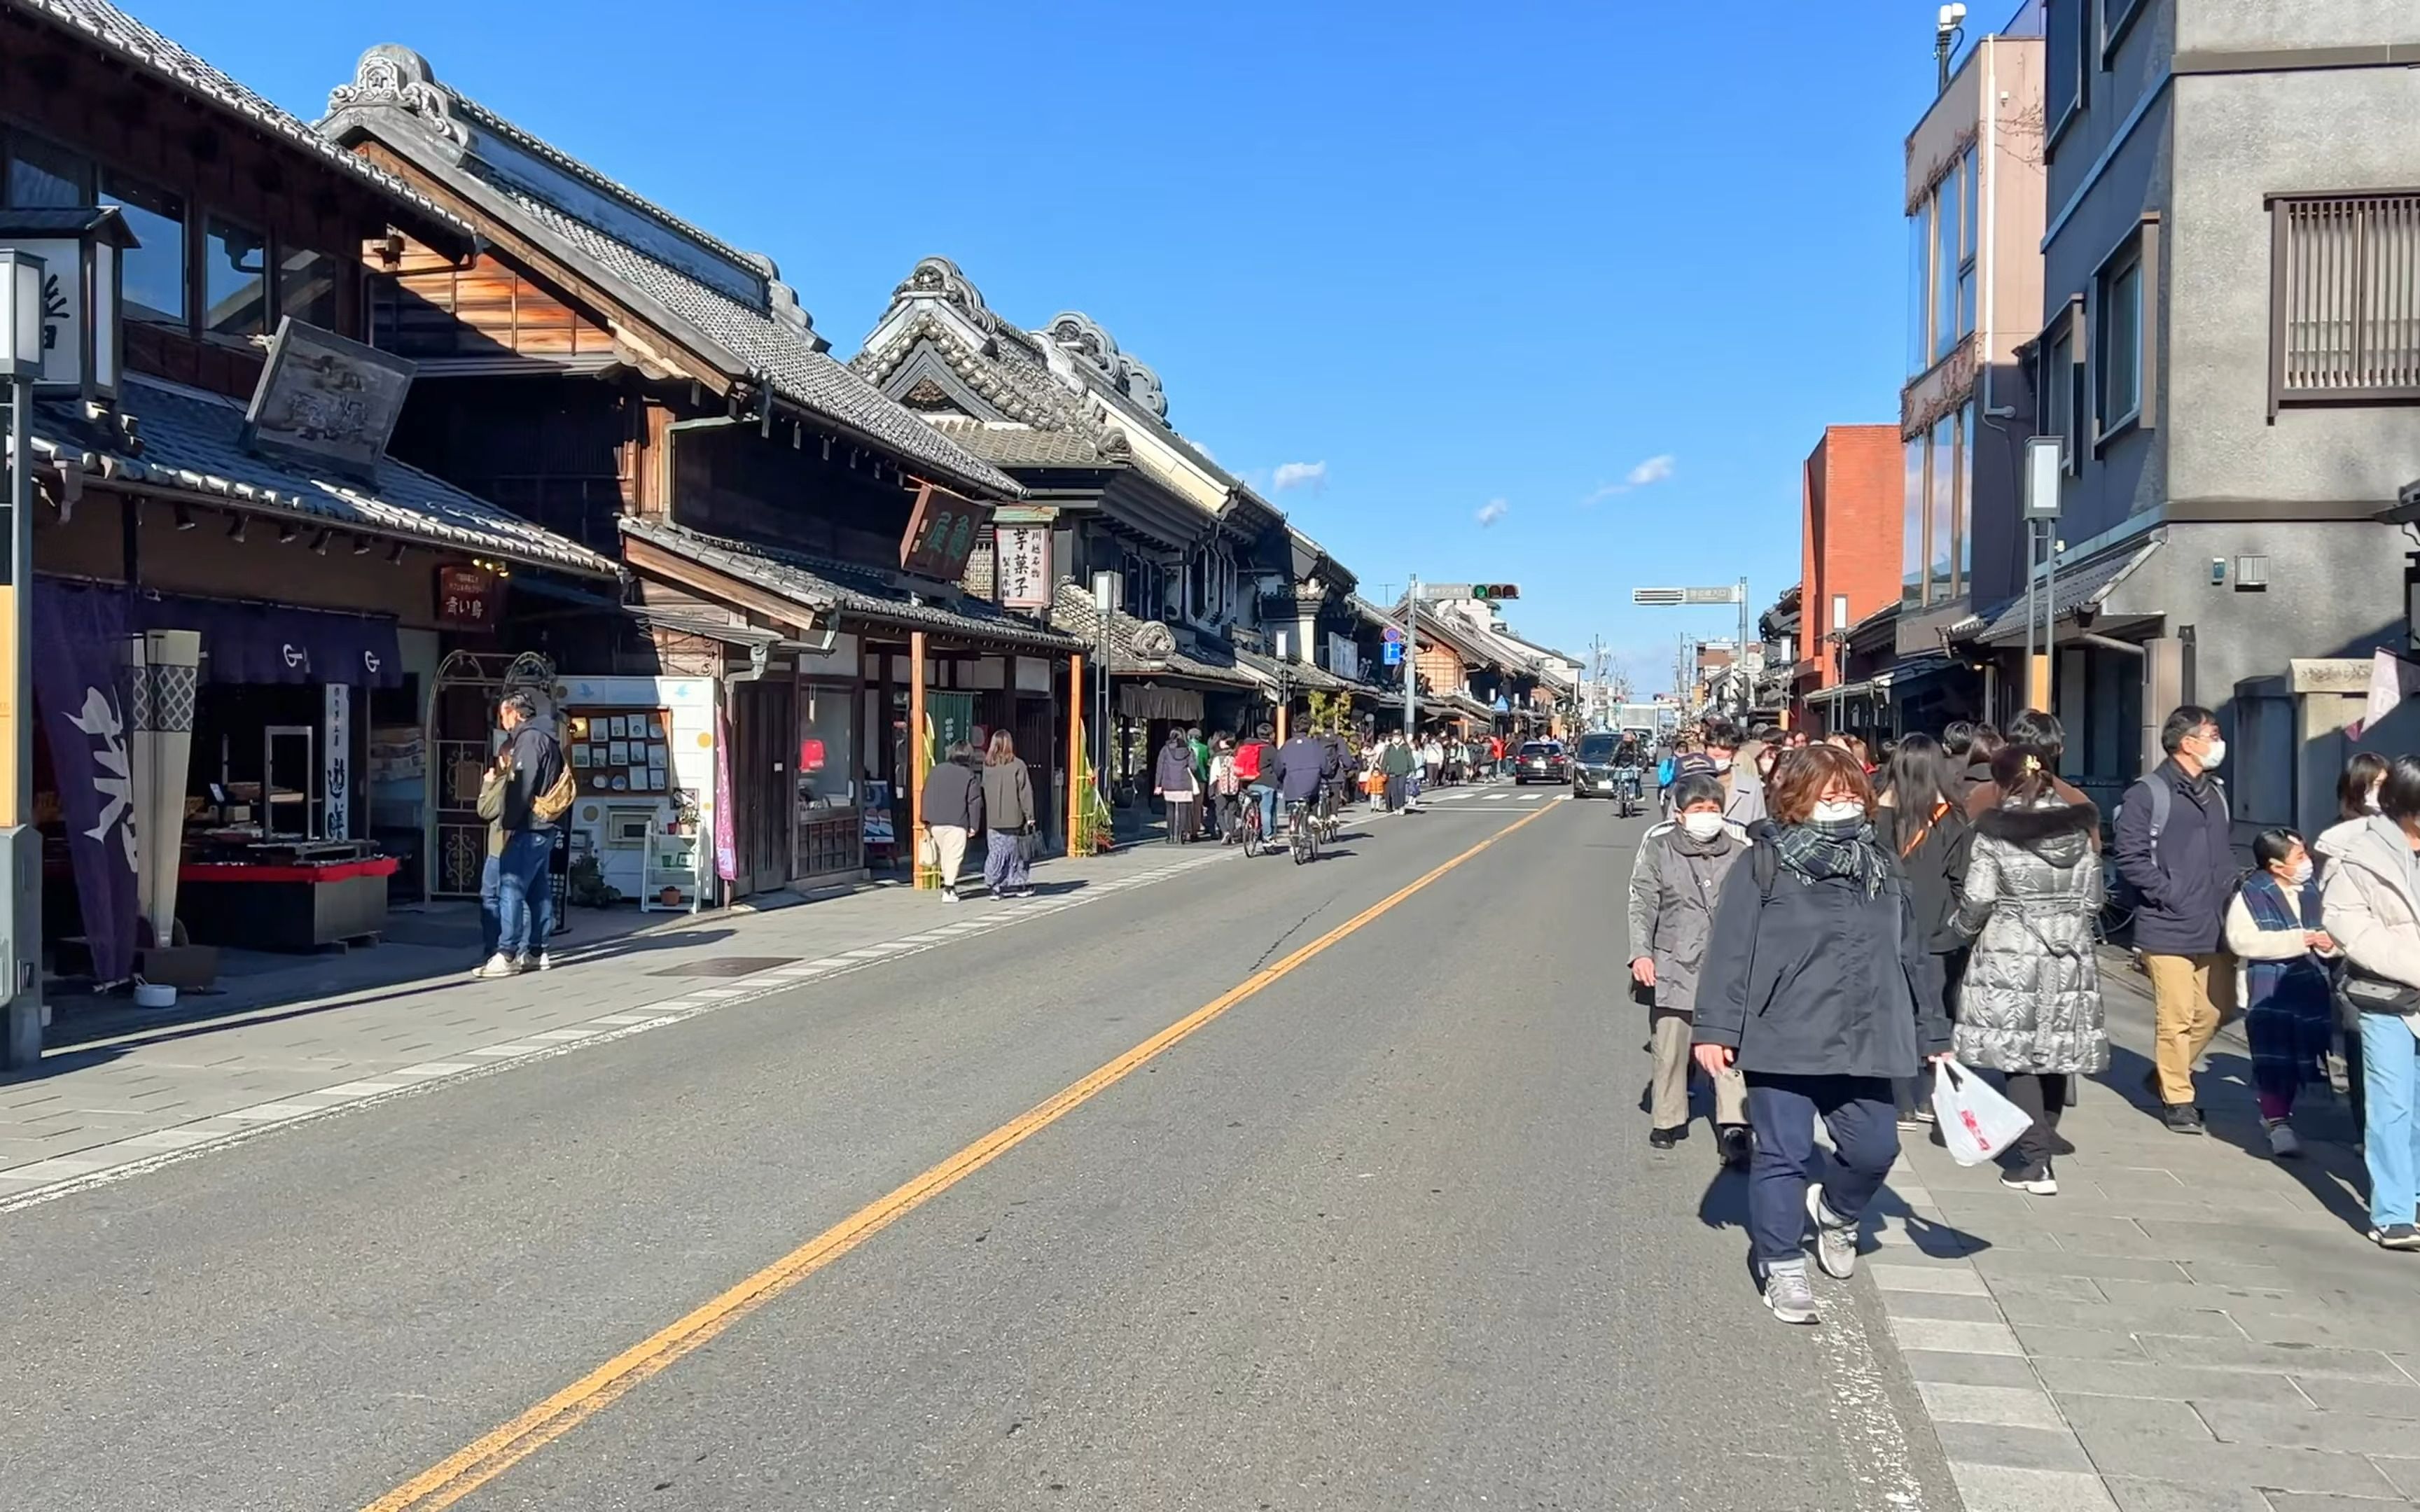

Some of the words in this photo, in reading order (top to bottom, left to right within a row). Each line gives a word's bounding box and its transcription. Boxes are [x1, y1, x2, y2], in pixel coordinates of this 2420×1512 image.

[1013, 528, 1029, 598] 芋菓子
[446, 596, 483, 620] 青い鳥
